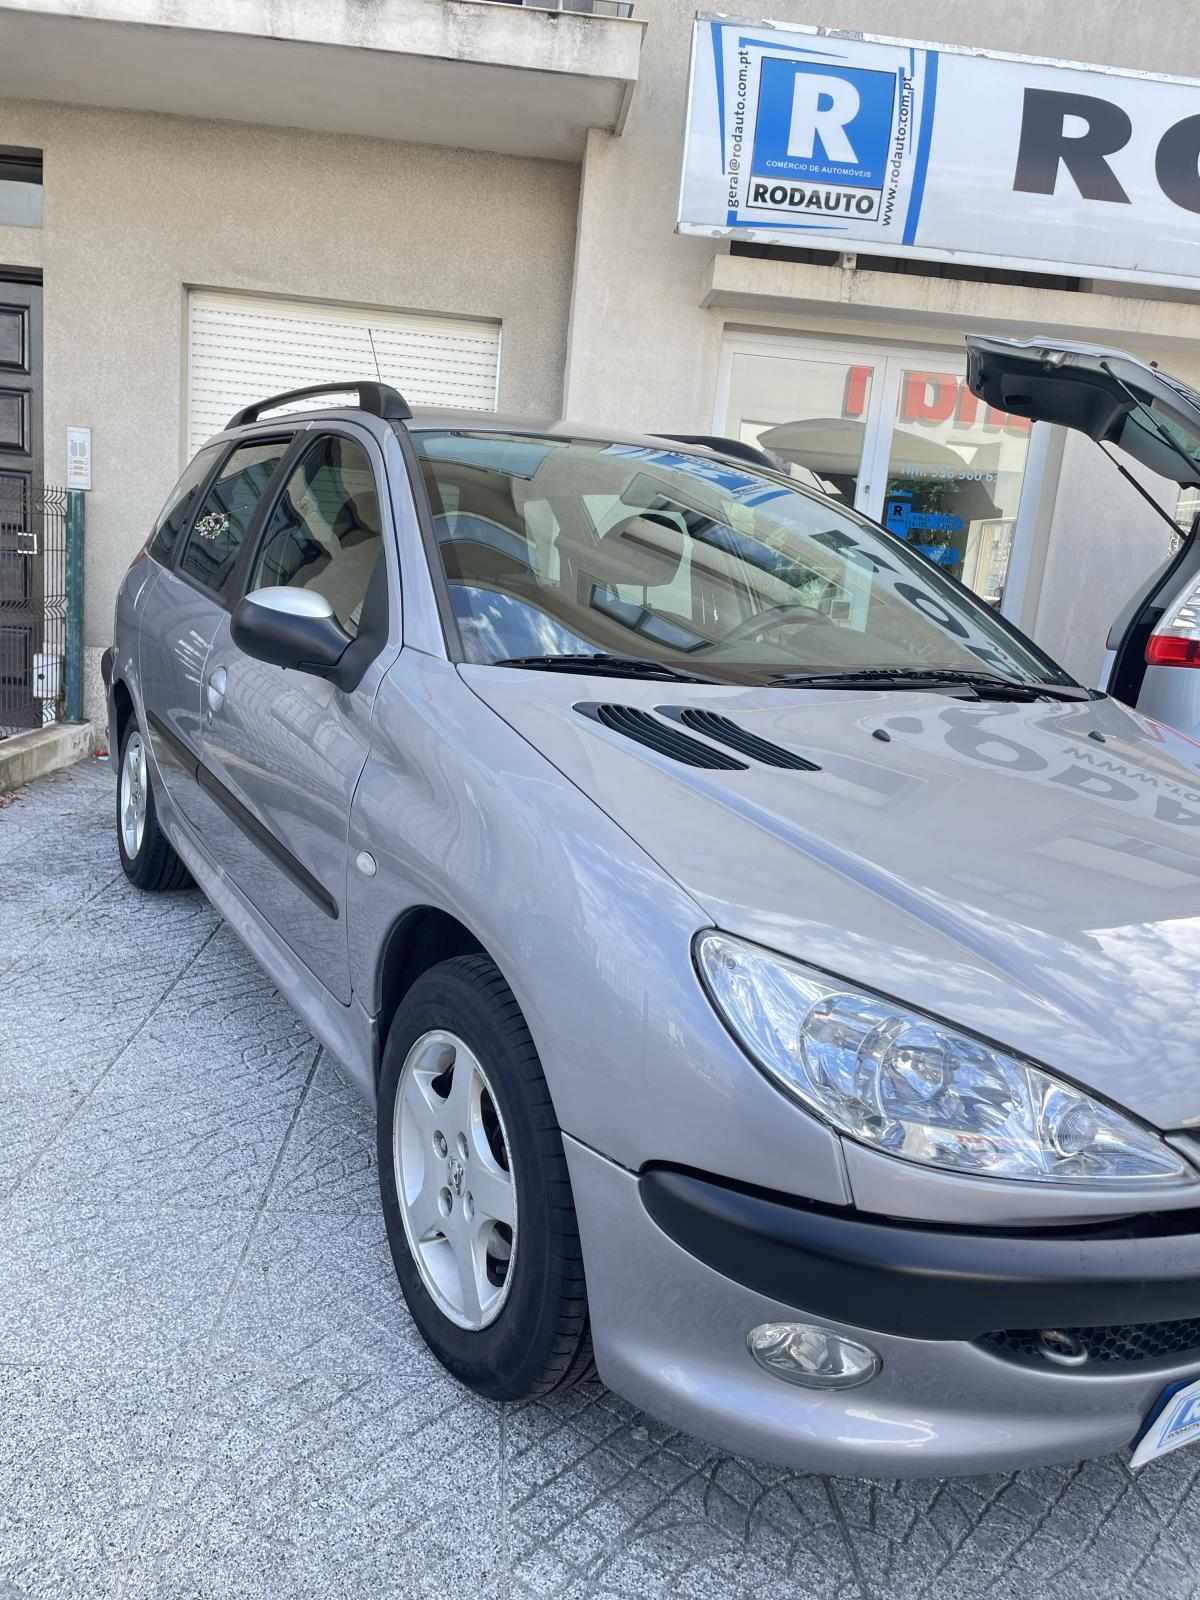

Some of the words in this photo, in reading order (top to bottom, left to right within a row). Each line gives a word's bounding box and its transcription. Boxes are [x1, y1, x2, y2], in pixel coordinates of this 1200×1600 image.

[727, 51, 751, 208] geral@rodauto.com.pt
[787, 72, 860, 164] R
[882, 76, 913, 226] www.rodauto.com.pt
[753, 183, 874, 214] RODAUTO
[766, 159, 807, 171] COMÉRCIO
[809, 164, 820, 172] DE
[821, 166, 872, 178] AUTOMÓVEIS
